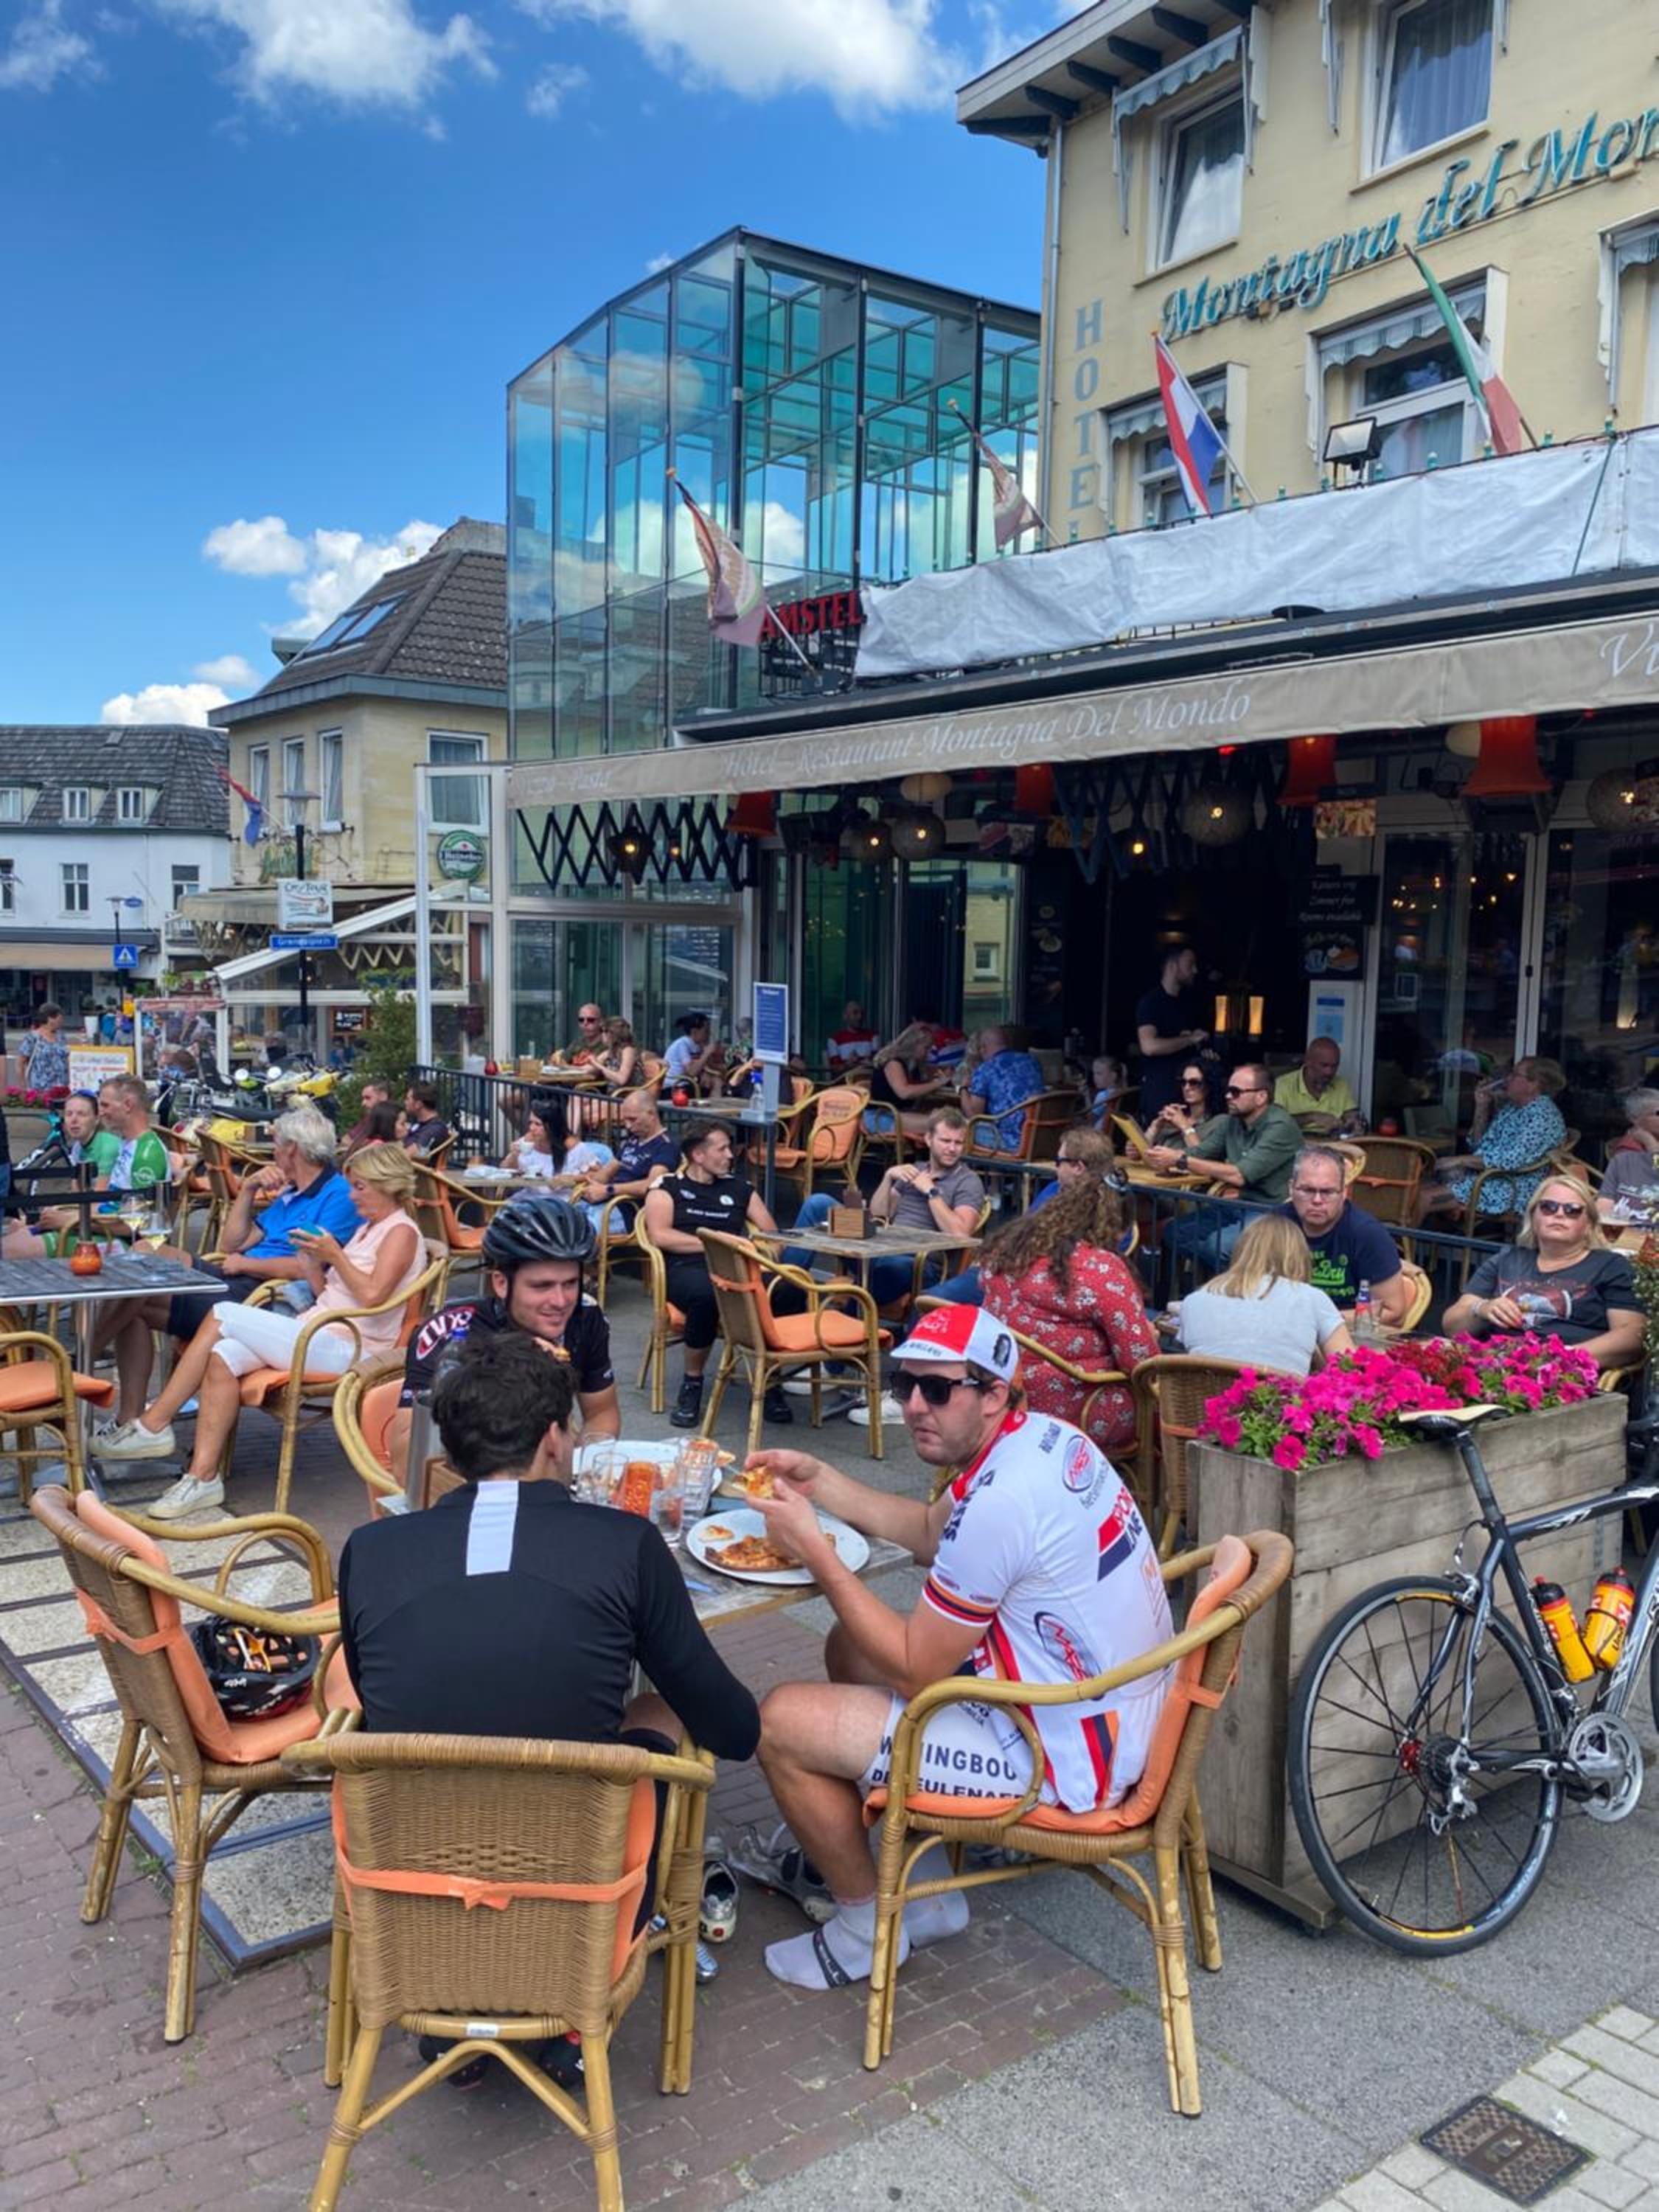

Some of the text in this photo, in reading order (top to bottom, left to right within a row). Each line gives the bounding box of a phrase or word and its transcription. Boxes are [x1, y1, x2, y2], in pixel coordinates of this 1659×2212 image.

[1162, 212, 1402, 344] Montagna
[1416, 139, 1519, 245] del
[758, 589, 863, 643] AMSTEL
[915, 718, 1059, 759] Montagna
[1064, 703, 1128, 739] Del
[1130, 678, 1251, 735] Mondo
